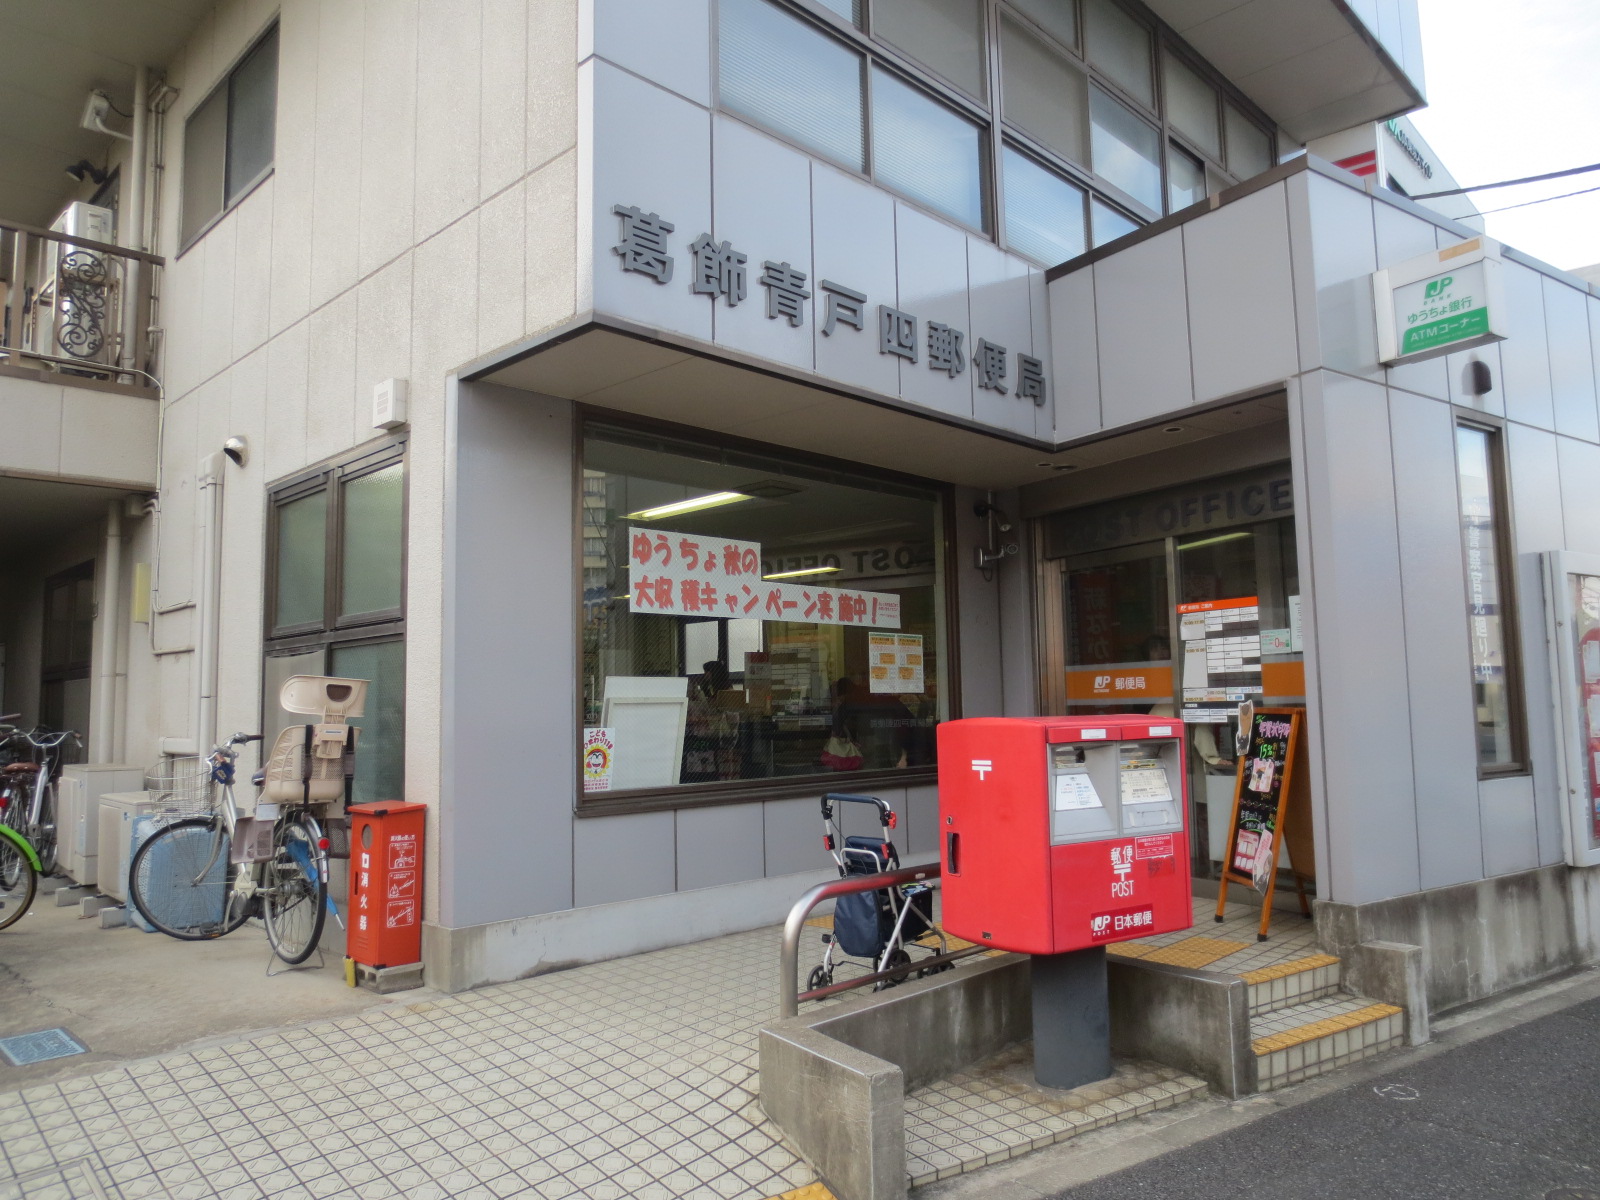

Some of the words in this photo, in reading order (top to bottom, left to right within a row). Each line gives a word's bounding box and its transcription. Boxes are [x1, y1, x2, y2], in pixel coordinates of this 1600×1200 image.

[613, 204, 1047, 407] 葛飾青戸四郵便局
[1407, 296, 1473, 324] ゆうちょ銀行
[1410, 317, 1481, 342] ATMコーナー
[1157, 478, 1292, 532] OFFICE
[632, 532, 758, 576] ゆうちょ秋の
[1115, 676, 1146, 690] 郵便局
[589, 729, 607, 738] こども
[1110, 845, 1134, 866] 郵便
[1111, 880, 1135, 899] POST
[1114, 910, 1153, 931] 日本郵便
